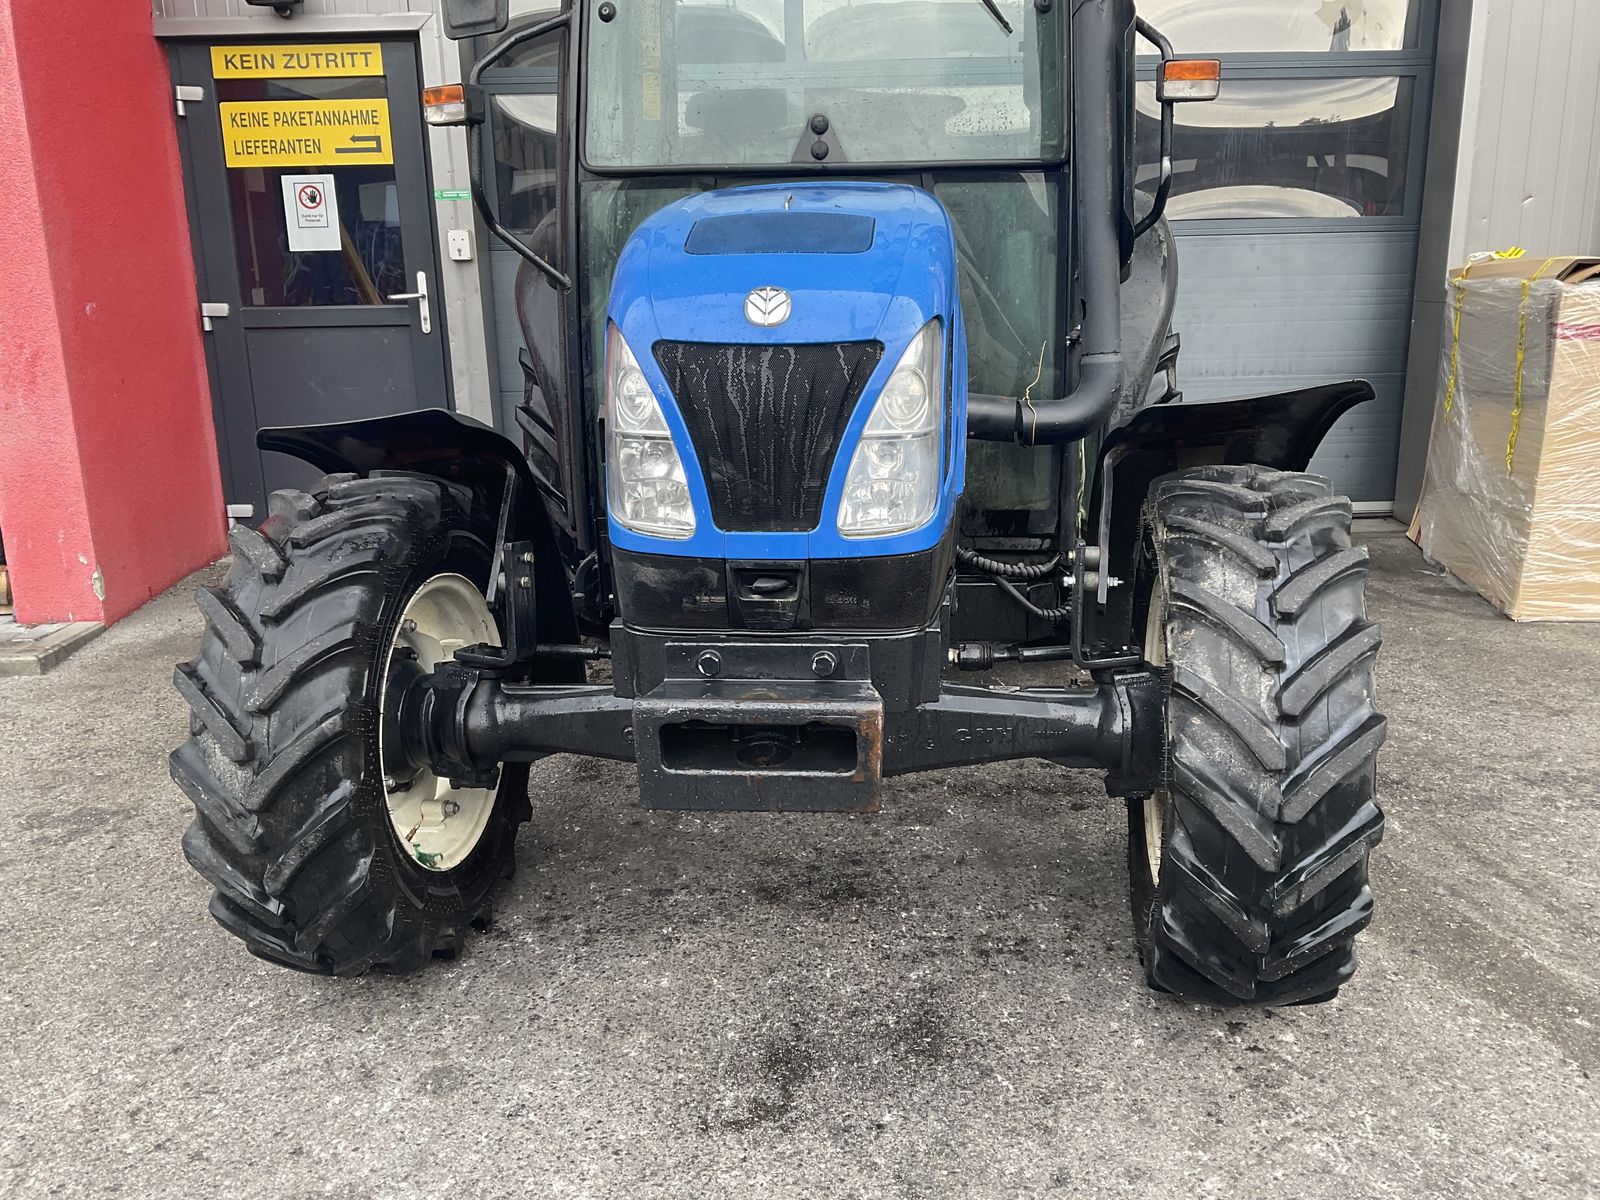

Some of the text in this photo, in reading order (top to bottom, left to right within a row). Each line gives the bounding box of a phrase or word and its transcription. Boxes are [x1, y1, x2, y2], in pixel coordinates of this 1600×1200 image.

[224, 51, 372, 70] KEIN ZUTRITT
[230, 109, 380, 128] KEINE PAKETANNAHME
[233, 138, 322, 156] LIEFERANTEN
